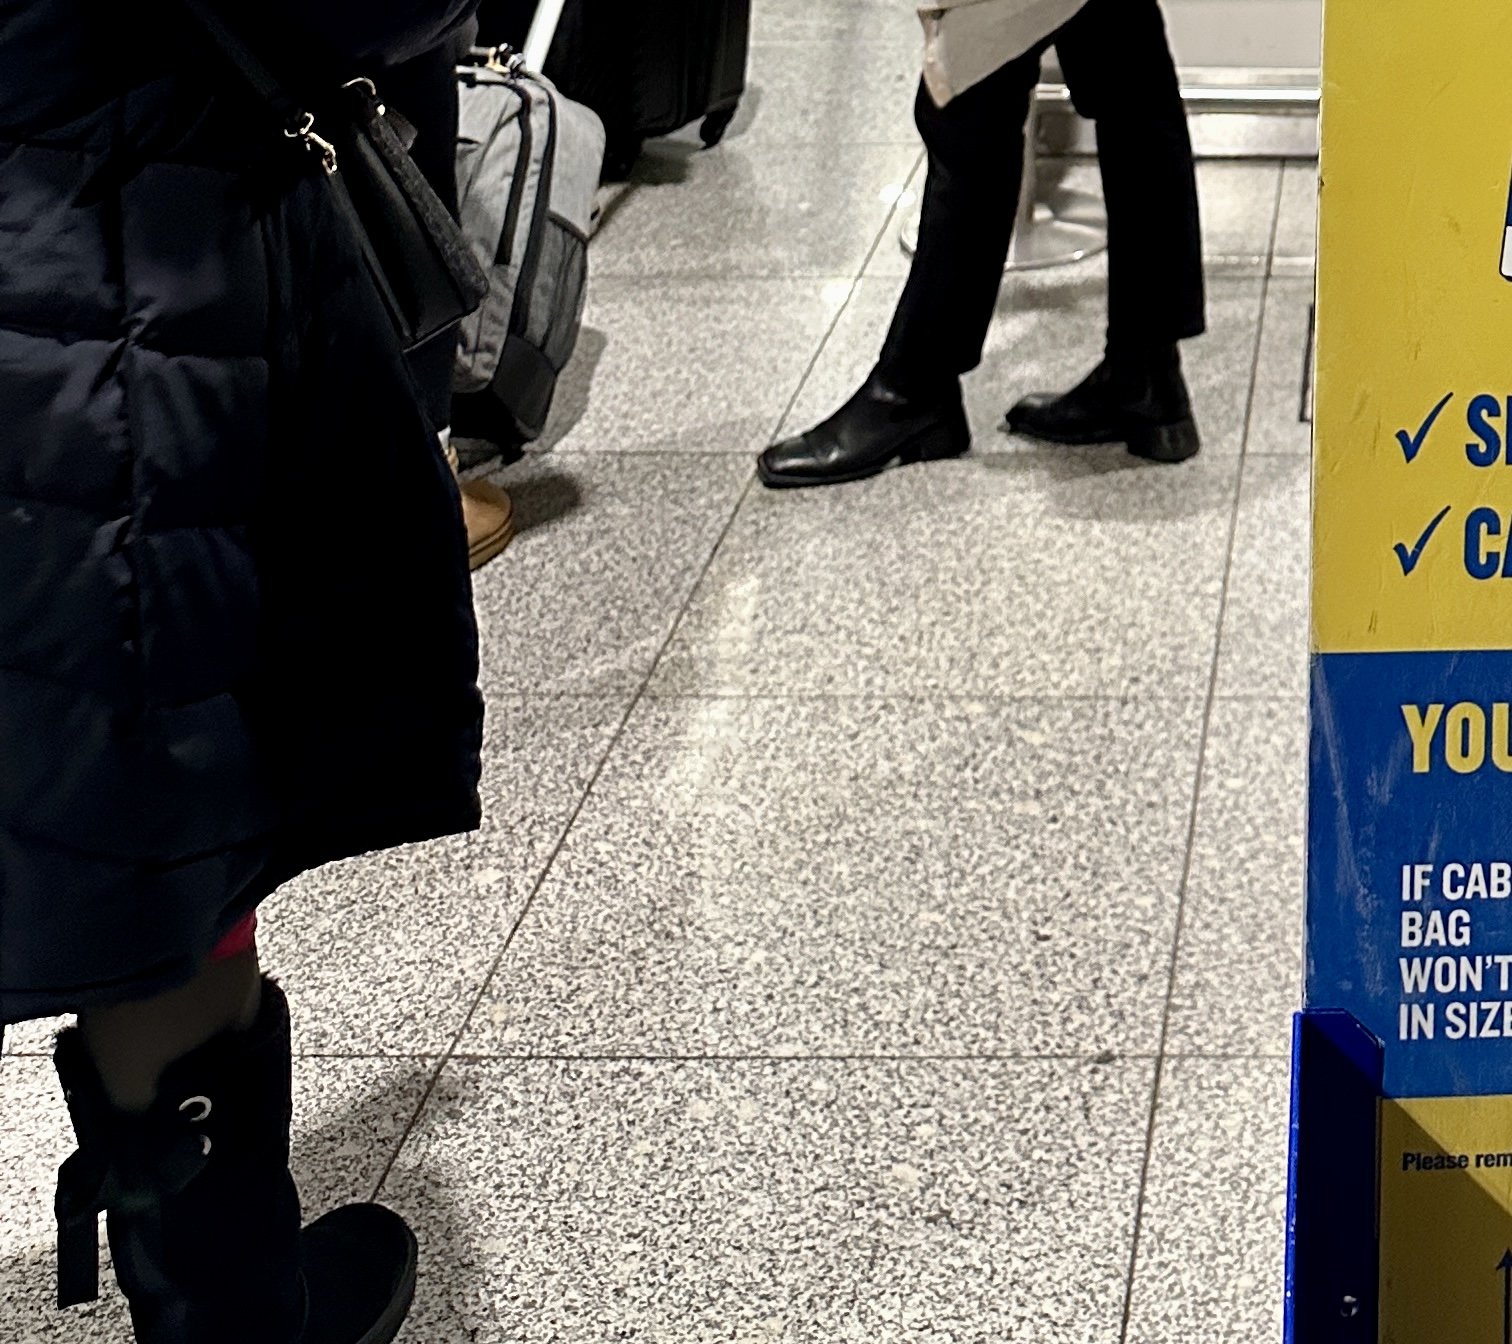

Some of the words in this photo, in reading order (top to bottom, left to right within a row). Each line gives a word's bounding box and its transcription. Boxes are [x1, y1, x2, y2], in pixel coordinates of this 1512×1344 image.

[1402, 864, 1433, 901] IF
[1401, 909, 1470, 947] BAG
[1400, 1003, 1434, 1040] IN
[1402, 1152, 1469, 1171] Please
